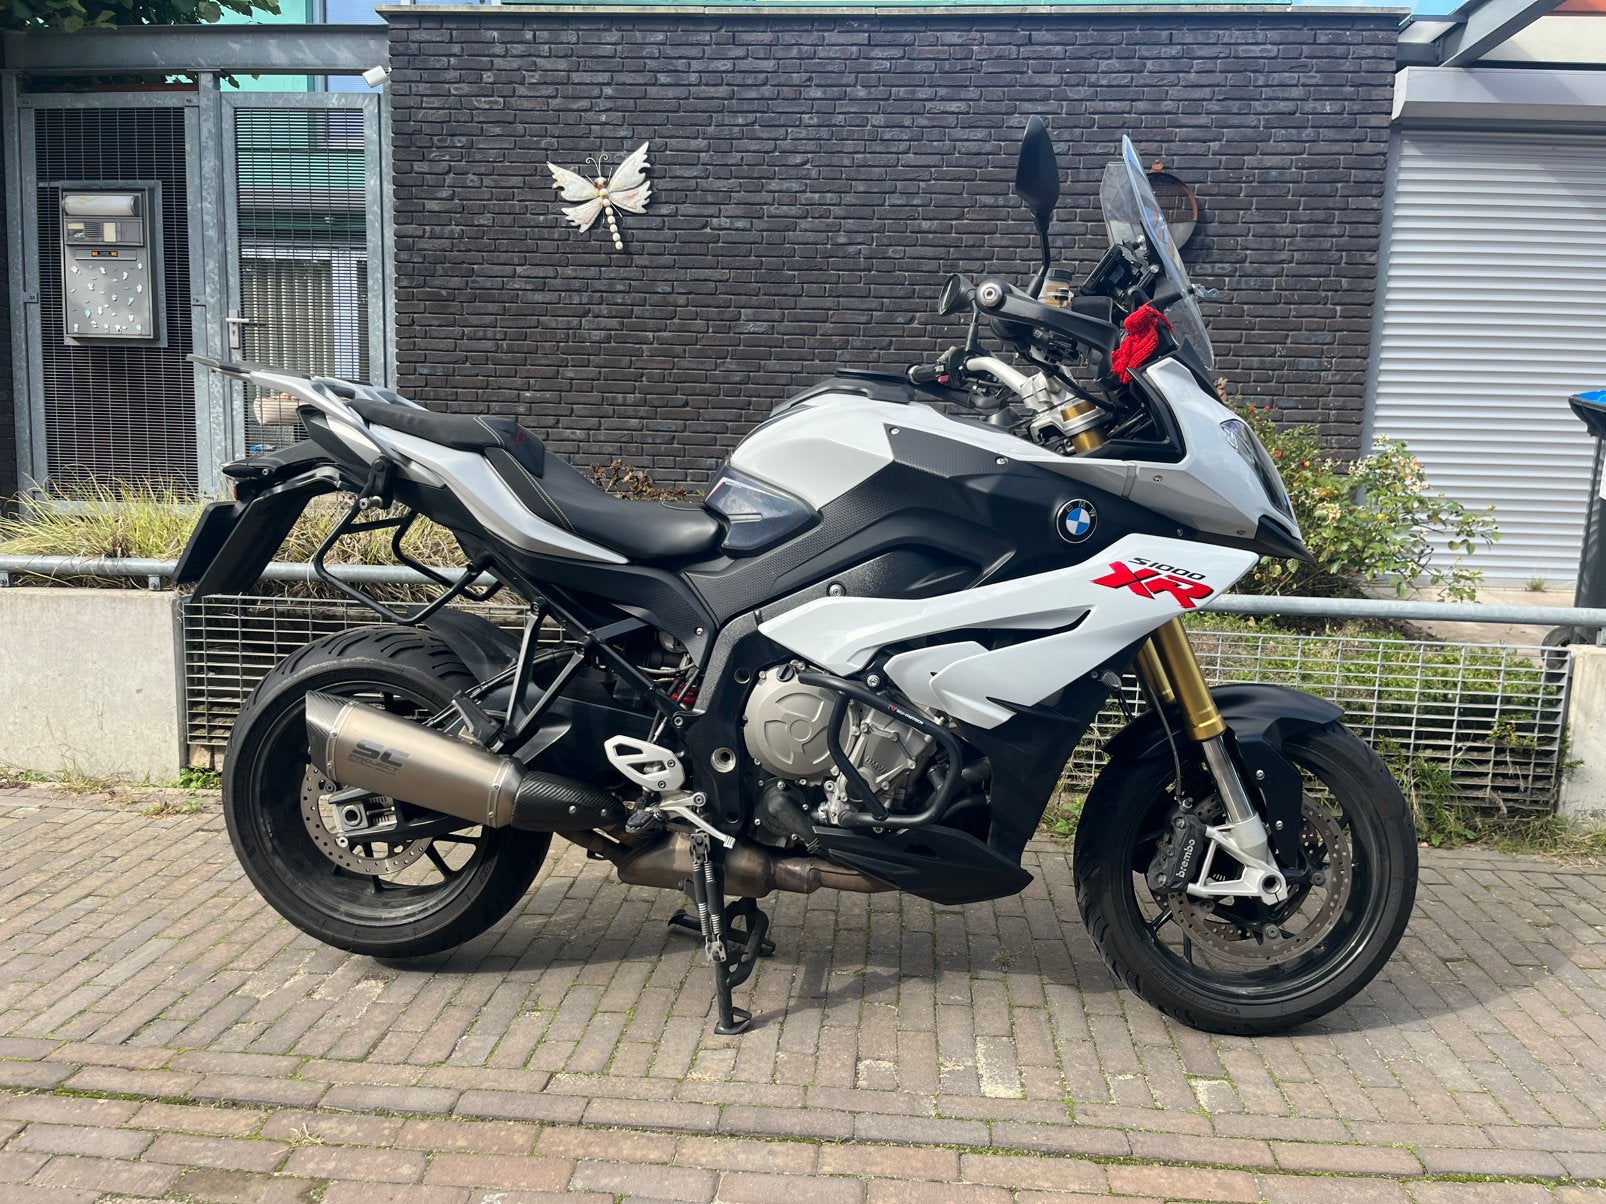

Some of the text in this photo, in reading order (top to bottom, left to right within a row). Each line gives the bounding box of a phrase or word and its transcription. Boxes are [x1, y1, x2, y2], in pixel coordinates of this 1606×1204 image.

[1065, 500, 1097, 517] BMW
[1128, 557, 1206, 580] S1000
[1090, 561, 1214, 609] XR
[348, 753, 401, 772] PROJECT
[352, 740, 410, 768] SC
[865, 755, 888, 774] BMW
[1175, 839, 1196, 878] brembo
